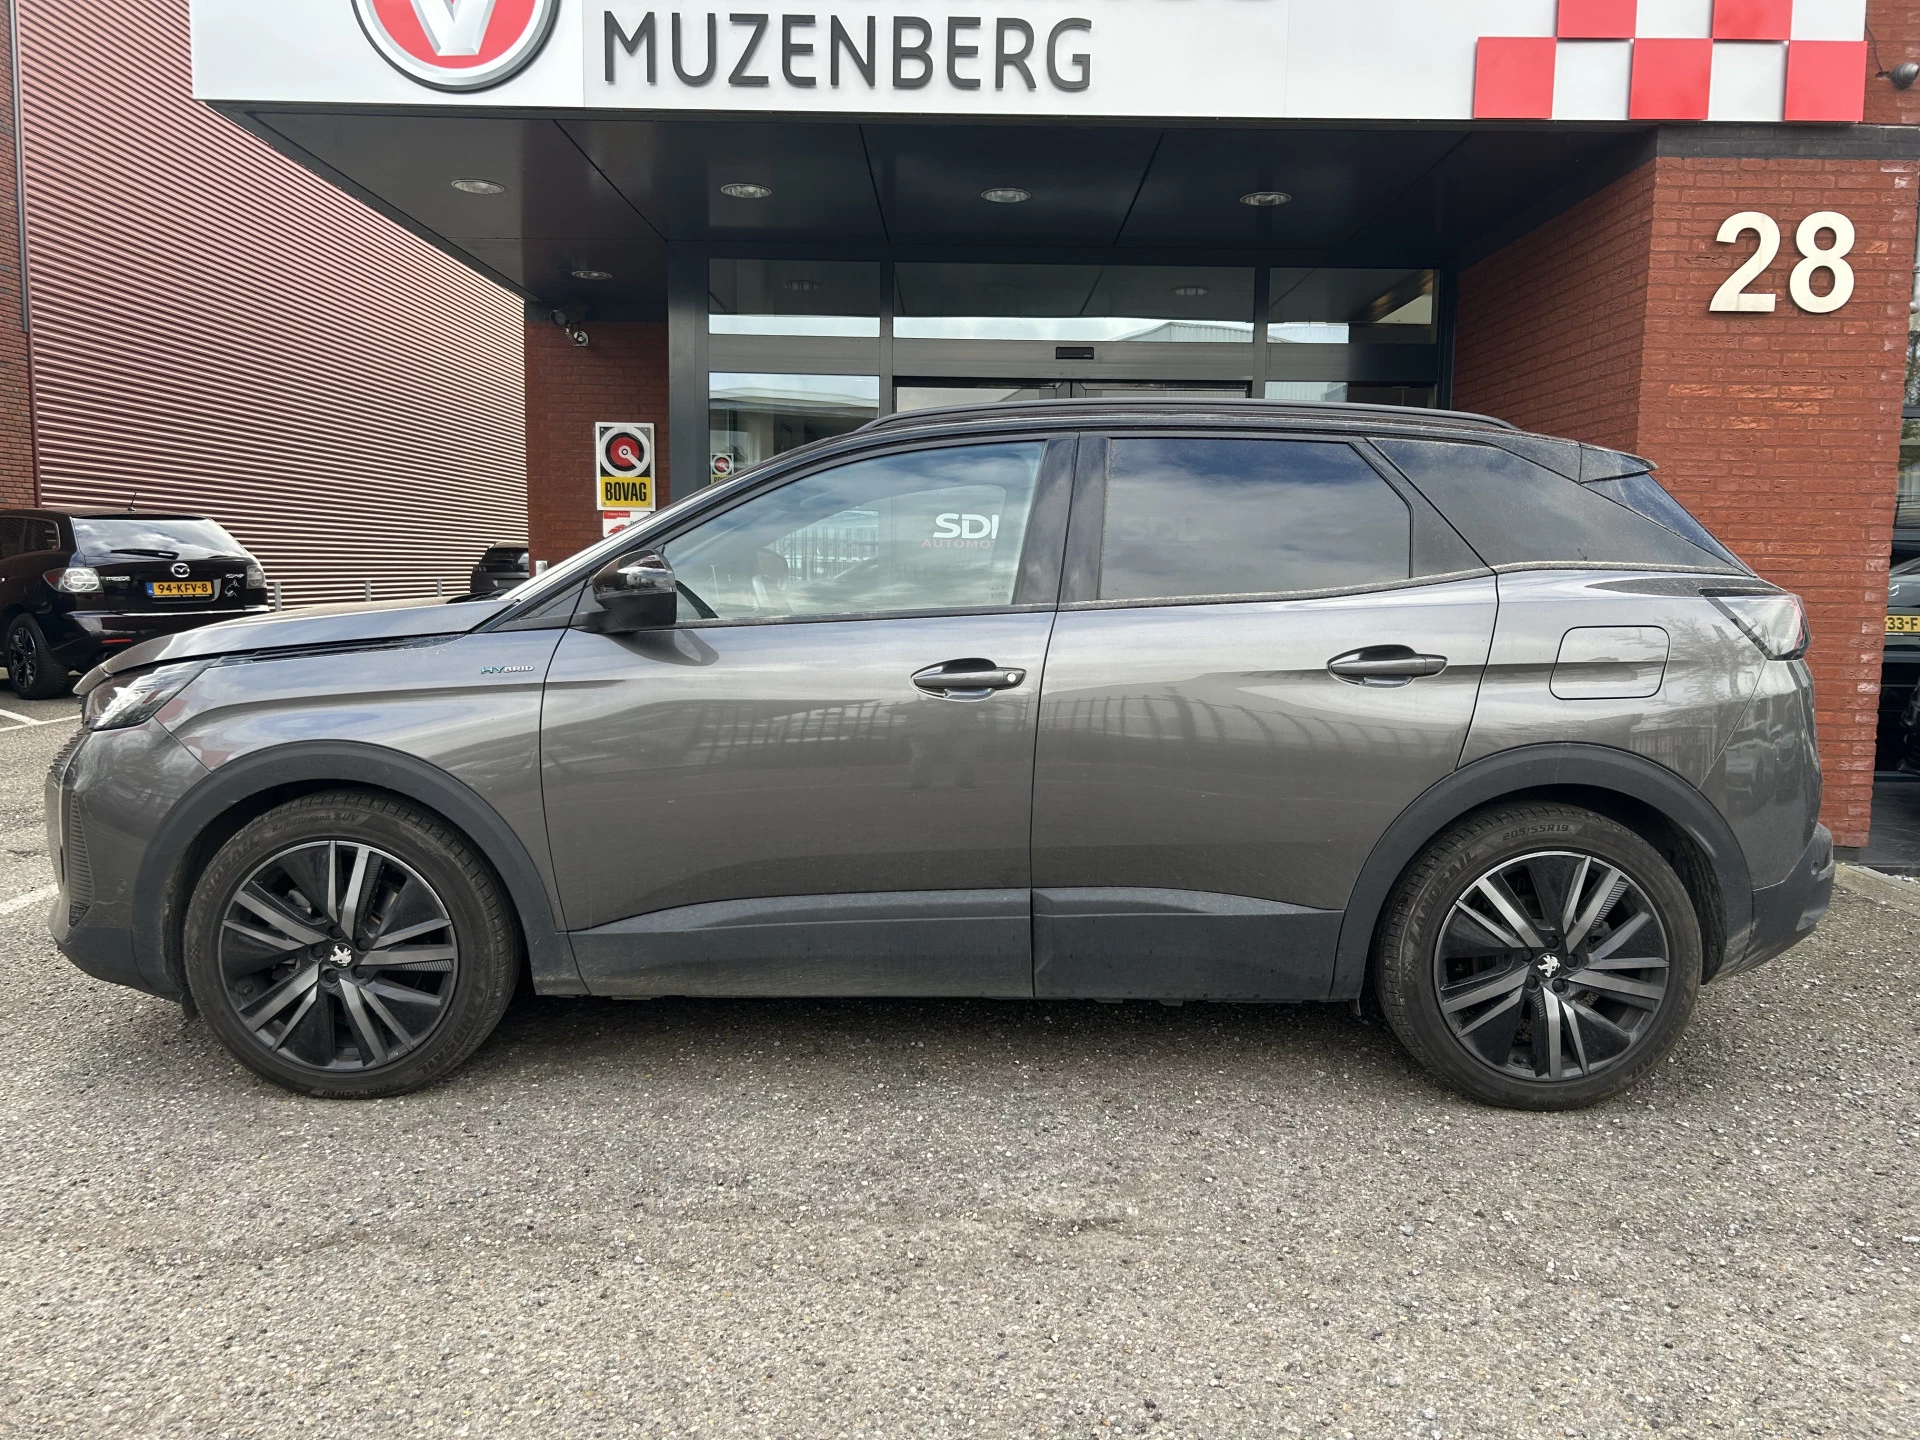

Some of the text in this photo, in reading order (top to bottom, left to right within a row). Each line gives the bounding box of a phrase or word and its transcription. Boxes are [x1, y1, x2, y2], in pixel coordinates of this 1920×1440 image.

[604, 11, 1093, 91] MUZENBERG
[1709, 211, 1855, 314] 28
[605, 482, 647, 502] BOVAG
[921, 539, 995, 549] AUTOMO
[158, 583, 208, 594] 94-KFV-8
[481, 665, 534, 674] HYBRID
[1503, 824, 1569, 841] 205/55R19
